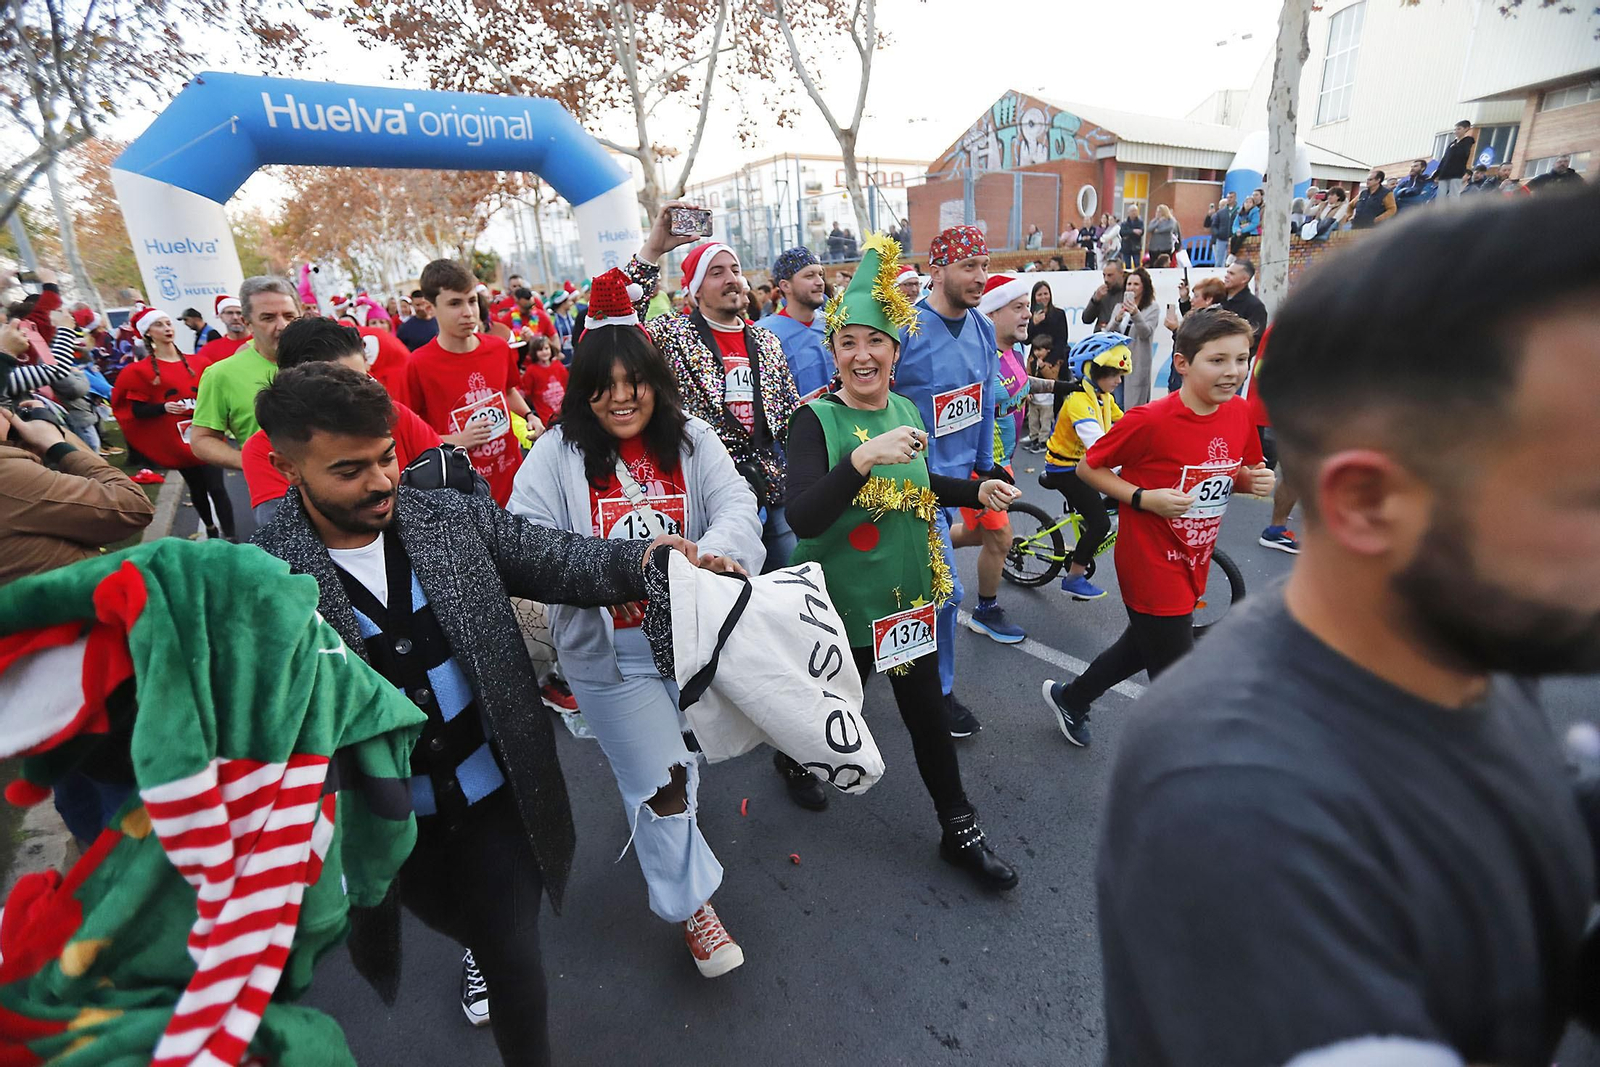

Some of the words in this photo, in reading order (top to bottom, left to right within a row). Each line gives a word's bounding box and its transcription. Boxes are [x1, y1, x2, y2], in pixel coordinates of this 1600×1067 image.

[260, 91, 414, 135] Huelva
[418, 104, 533, 146] original
[144, 237, 219, 254] Huelva
[184, 286, 227, 296] HUELVA
[947, 397, 970, 420] 281
[1199, 479, 1232, 501] 524
[889, 620, 921, 648] 137
